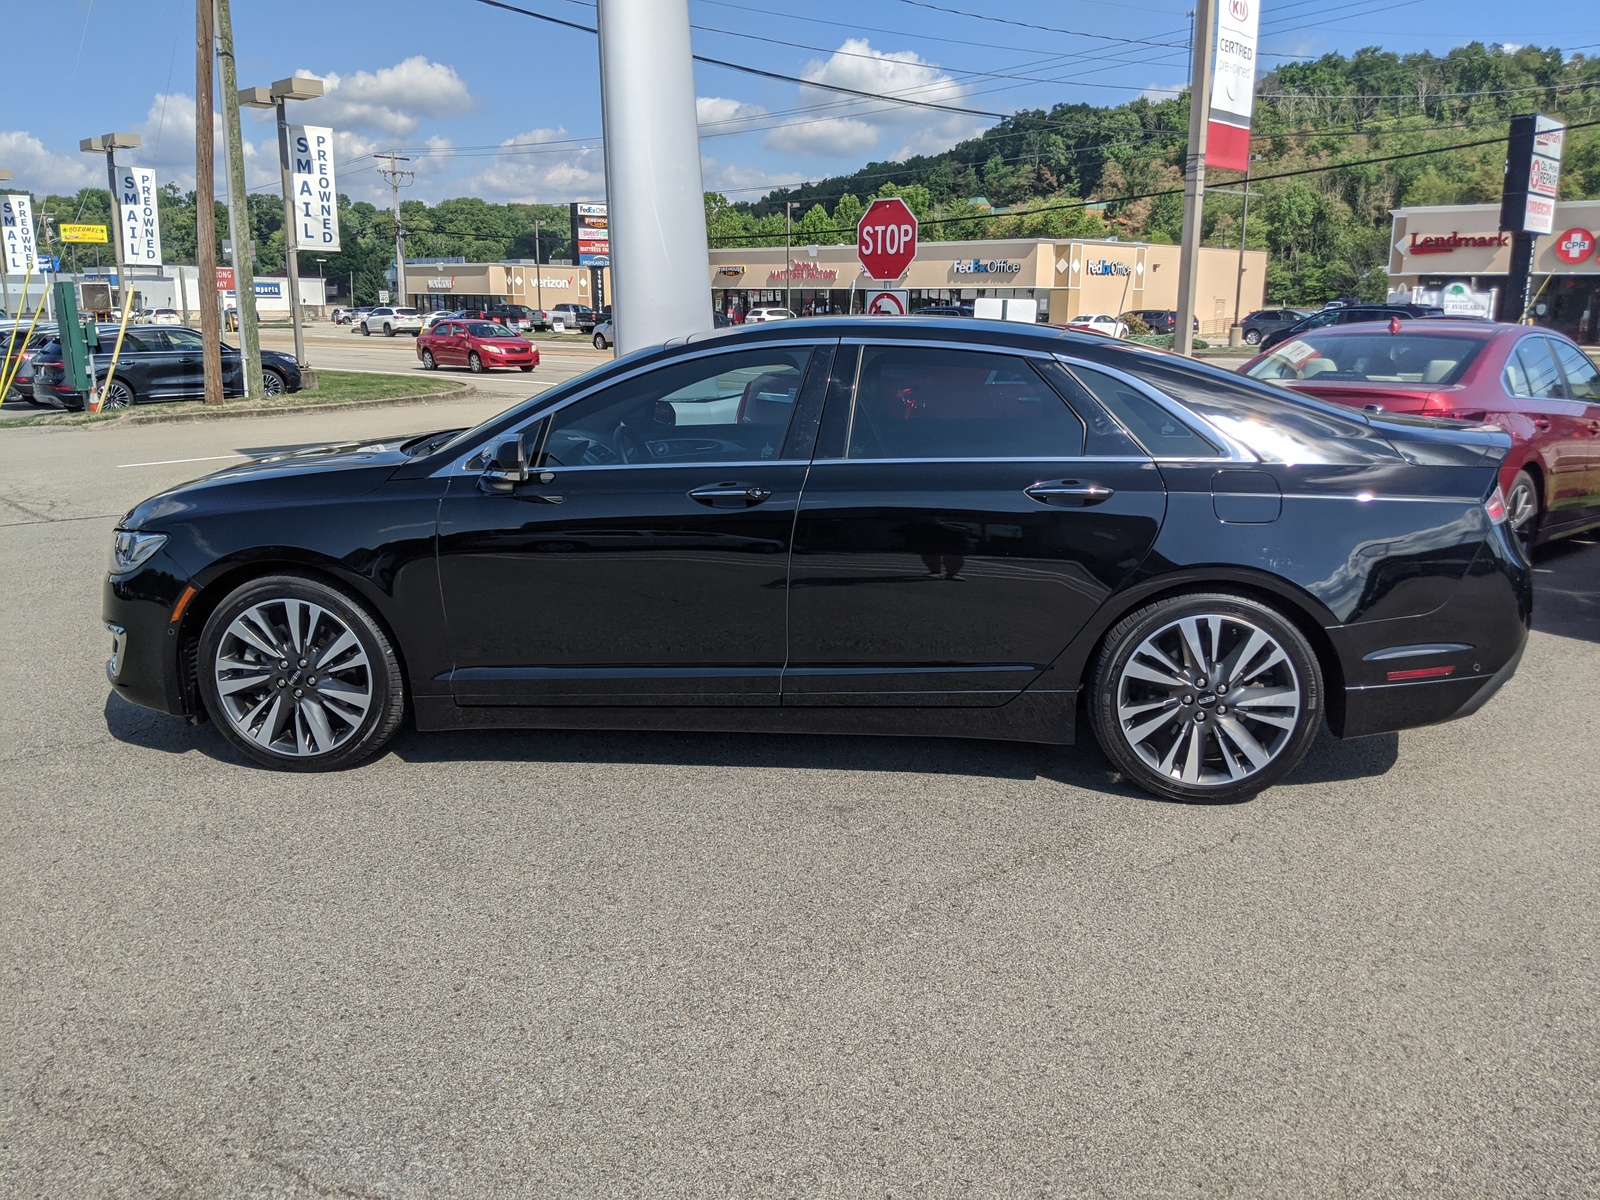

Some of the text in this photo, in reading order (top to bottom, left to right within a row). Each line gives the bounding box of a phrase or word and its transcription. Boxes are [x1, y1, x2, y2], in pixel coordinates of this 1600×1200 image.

[296, 137, 315, 239] SMAIL
[316, 135, 333, 243] PREOWNED
[1539, 171, 1557, 187] REPAIR
[3, 202, 20, 268] SMAIL
[18, 200, 34, 270] PREOWNED
[124, 176, 140, 256] SMAIL
[141, 174, 156, 259] PREOWNED
[861, 224, 913, 255] STOP
[1410, 231, 1510, 249] Lendmark
[1564, 241, 1586, 250] CPR
[530, 276, 569, 289] verizon
